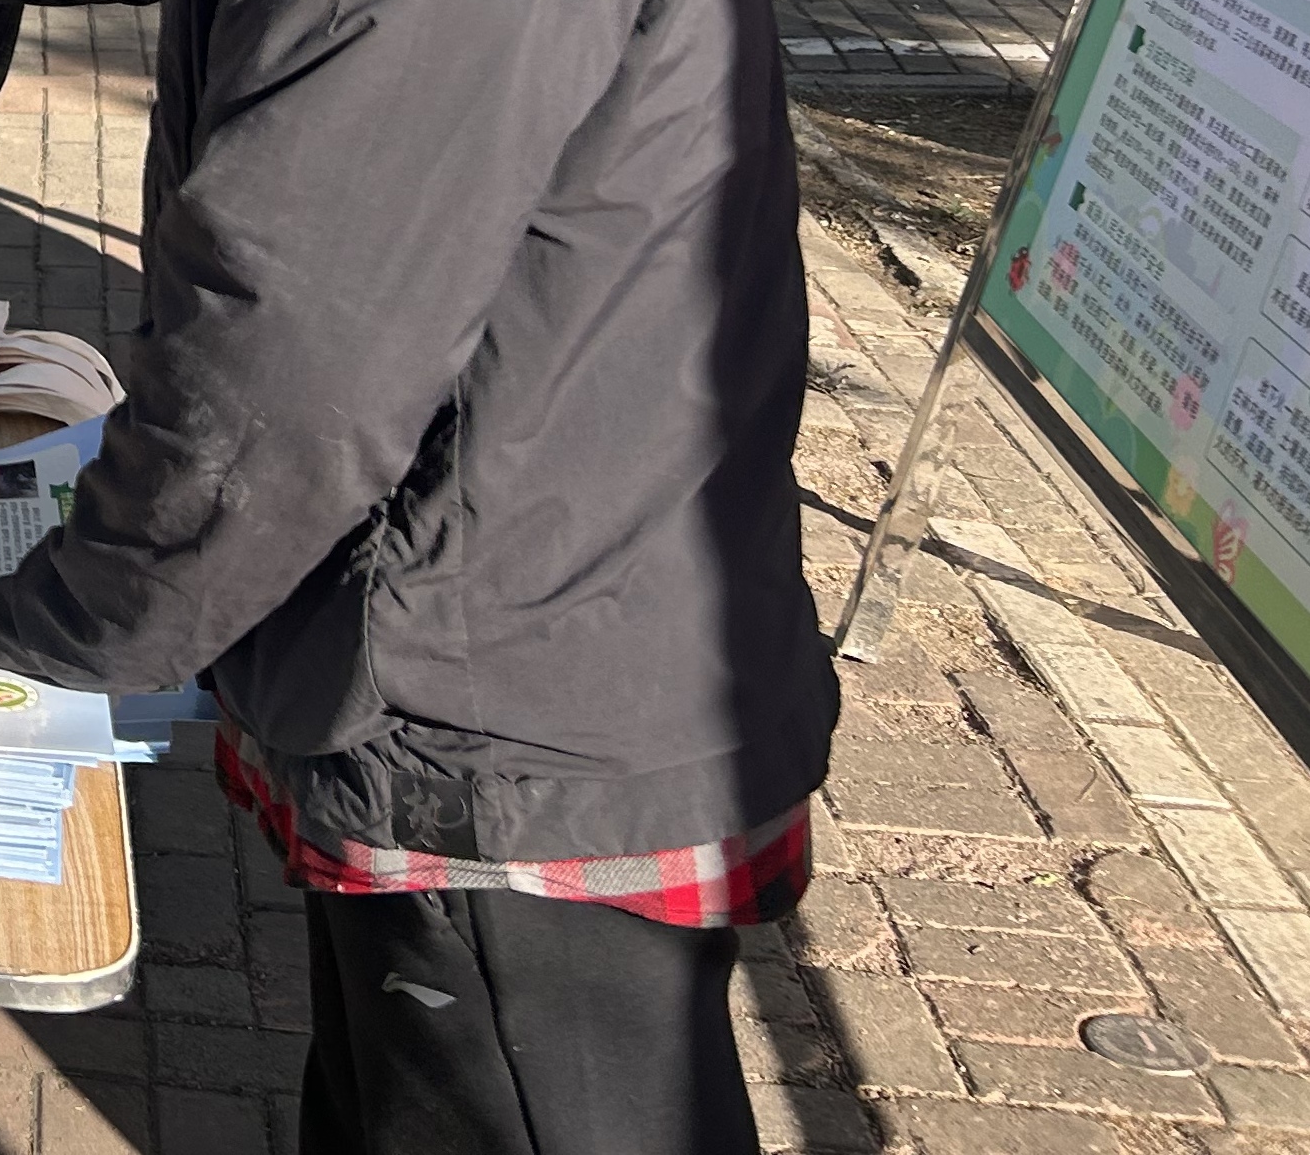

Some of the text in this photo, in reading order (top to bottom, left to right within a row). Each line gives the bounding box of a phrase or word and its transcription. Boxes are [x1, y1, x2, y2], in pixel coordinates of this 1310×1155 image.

[1084, 198, 1166, 282] 威胁人民生命财产安全
